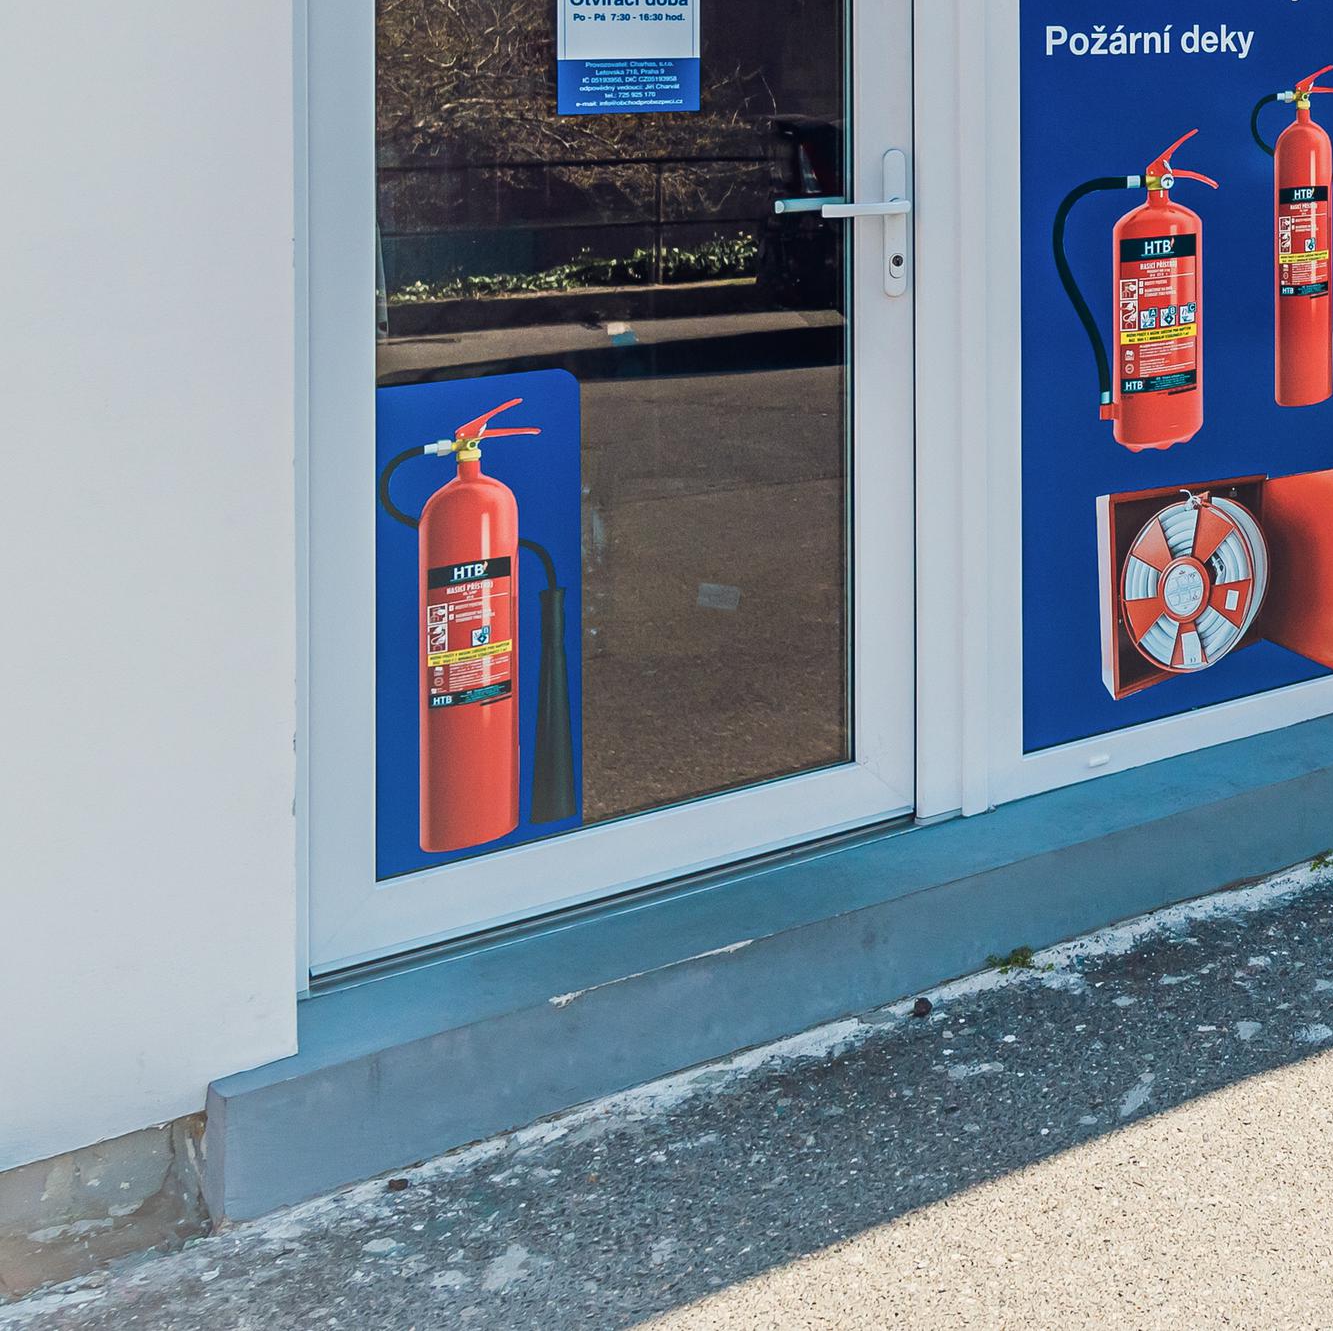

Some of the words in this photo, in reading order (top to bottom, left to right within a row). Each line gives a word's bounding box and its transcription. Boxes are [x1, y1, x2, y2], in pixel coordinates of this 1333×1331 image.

[573, 13, 586, 21] Po
[594, 13, 606, 21] Pá
[611, 13, 631, 21] 7:30
[640, 13, 664, 21] 16:30
[665, 13, 686, 21] hod.
[1045, 25, 1170, 56] Požární
[1180, 25, 1254, 59] deky
[1294, 188, 1312, 200] HTB
[1144, 240, 1172, 255] HTB
[1282, 287, 1294, 295] HTB
[1125, 380, 1144, 391] HTB
[453, 564, 485, 580] HTB
[433, 695, 453, 706] HTB
